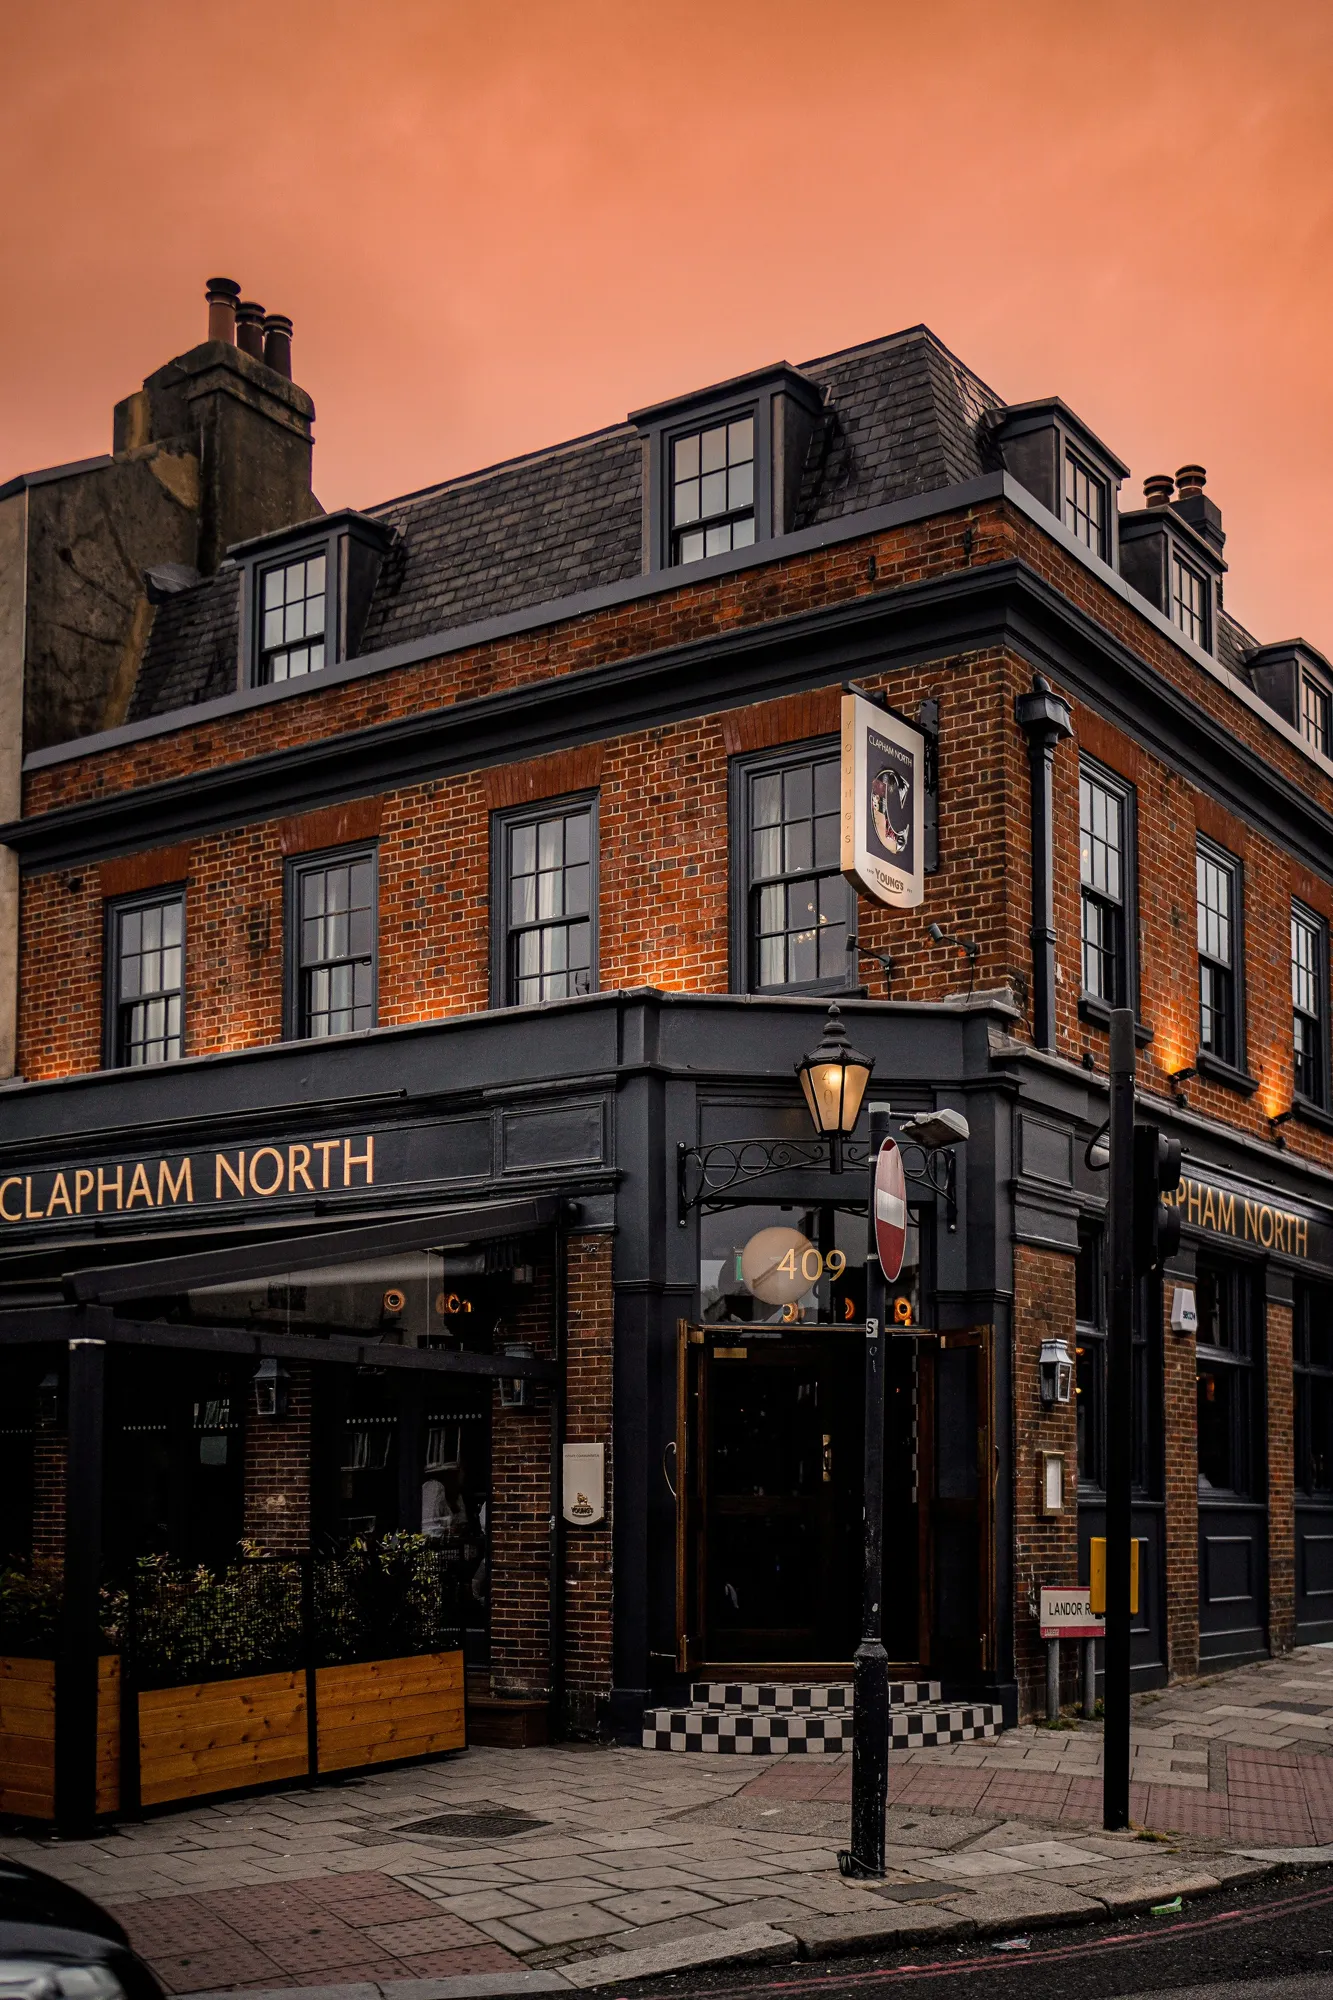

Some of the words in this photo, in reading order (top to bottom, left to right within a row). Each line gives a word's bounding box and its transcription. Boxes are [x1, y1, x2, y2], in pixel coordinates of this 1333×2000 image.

[868, 735, 894, 756] CLAPHAM
[894, 749, 913, 768] NORTH
[875, 868, 904, 891] YOUNG'S
[0, 1158, 194, 1222] CLAPHAM
[215, 1136, 375, 1199] NORTH
[1244, 1200, 1308, 1258] NORTH
[776, 1248, 847, 1282] 409
[1048, 1602, 1082, 1615] LANDOR
